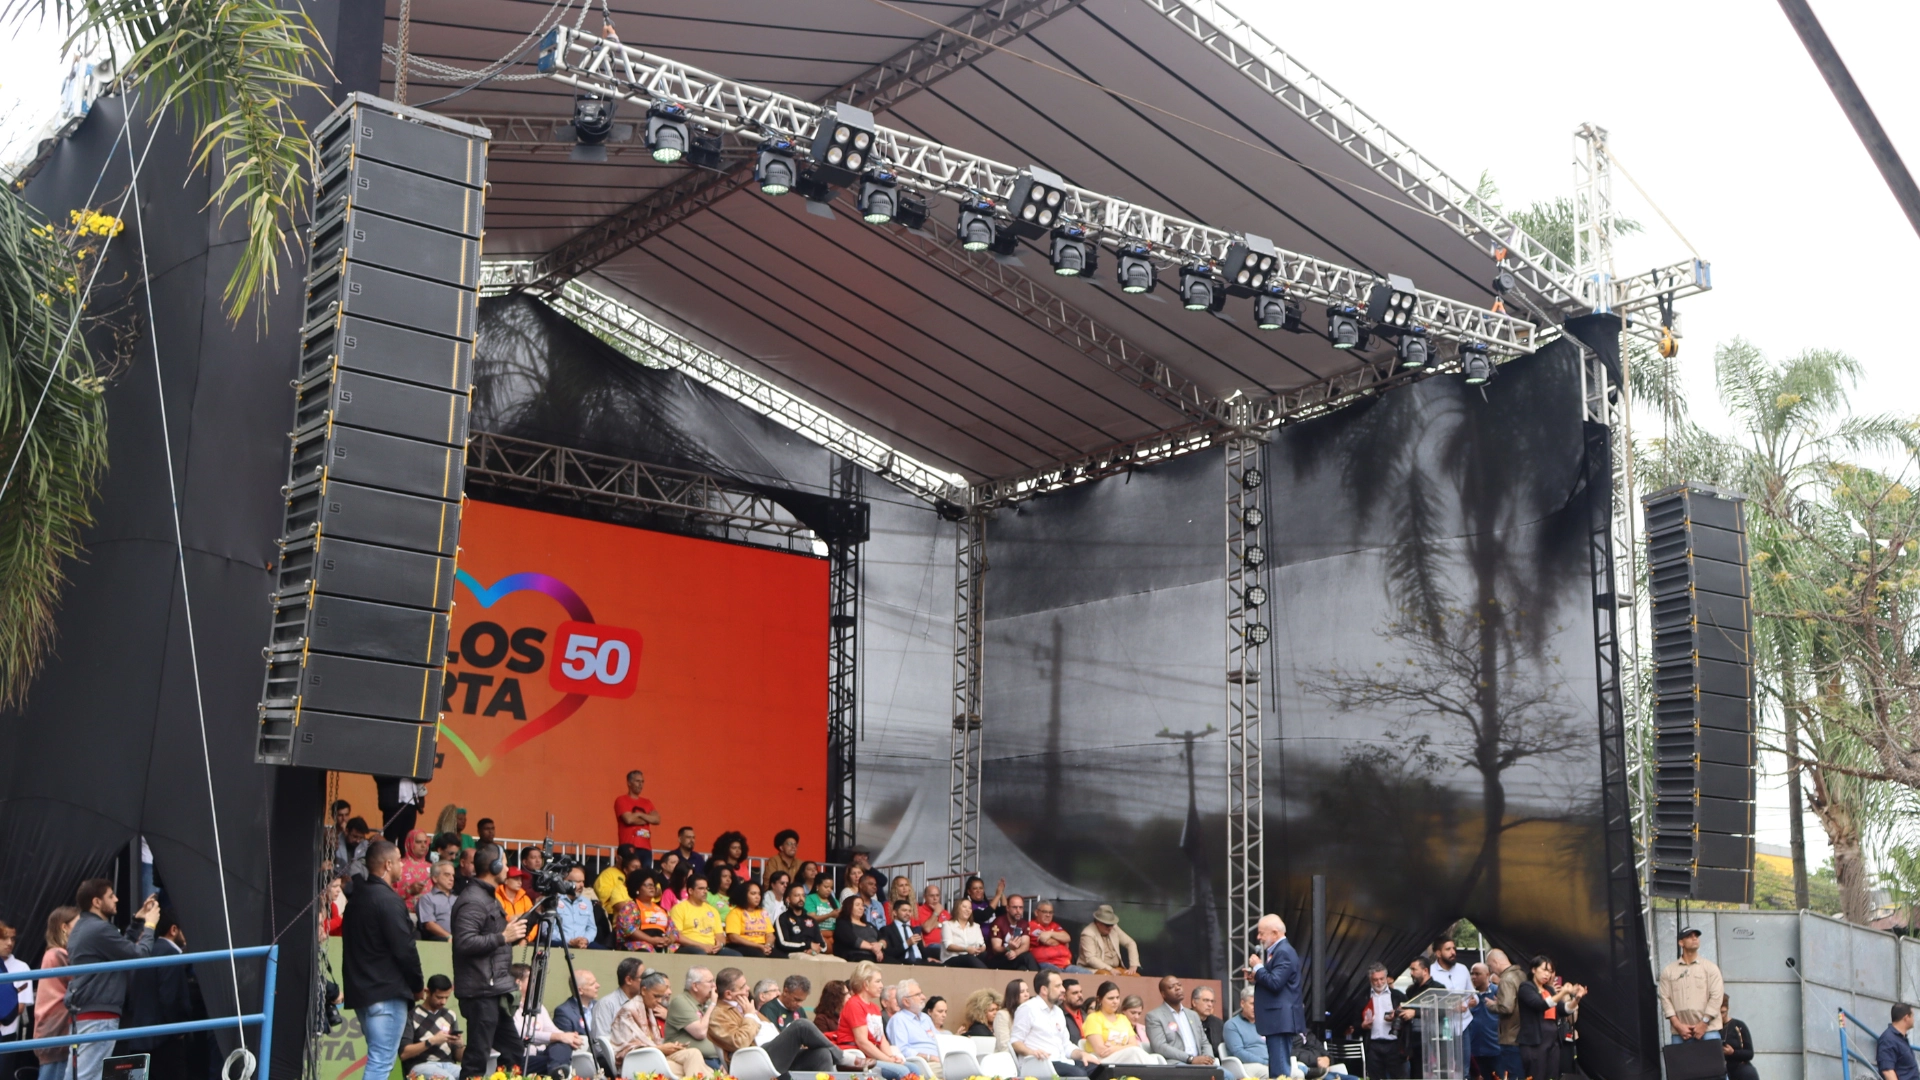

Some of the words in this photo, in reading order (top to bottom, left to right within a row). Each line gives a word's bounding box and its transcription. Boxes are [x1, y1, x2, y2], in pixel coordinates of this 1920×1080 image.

[361, 127, 372, 137] LS
[357, 178, 368, 188] LS
[353, 230, 364, 240] LS
[349, 283, 360, 293] LS
[344, 337, 355, 347] LS
[339, 392, 350, 402] LS
[562, 634, 630, 684] 50
[328, 1016, 364, 1039] OS
